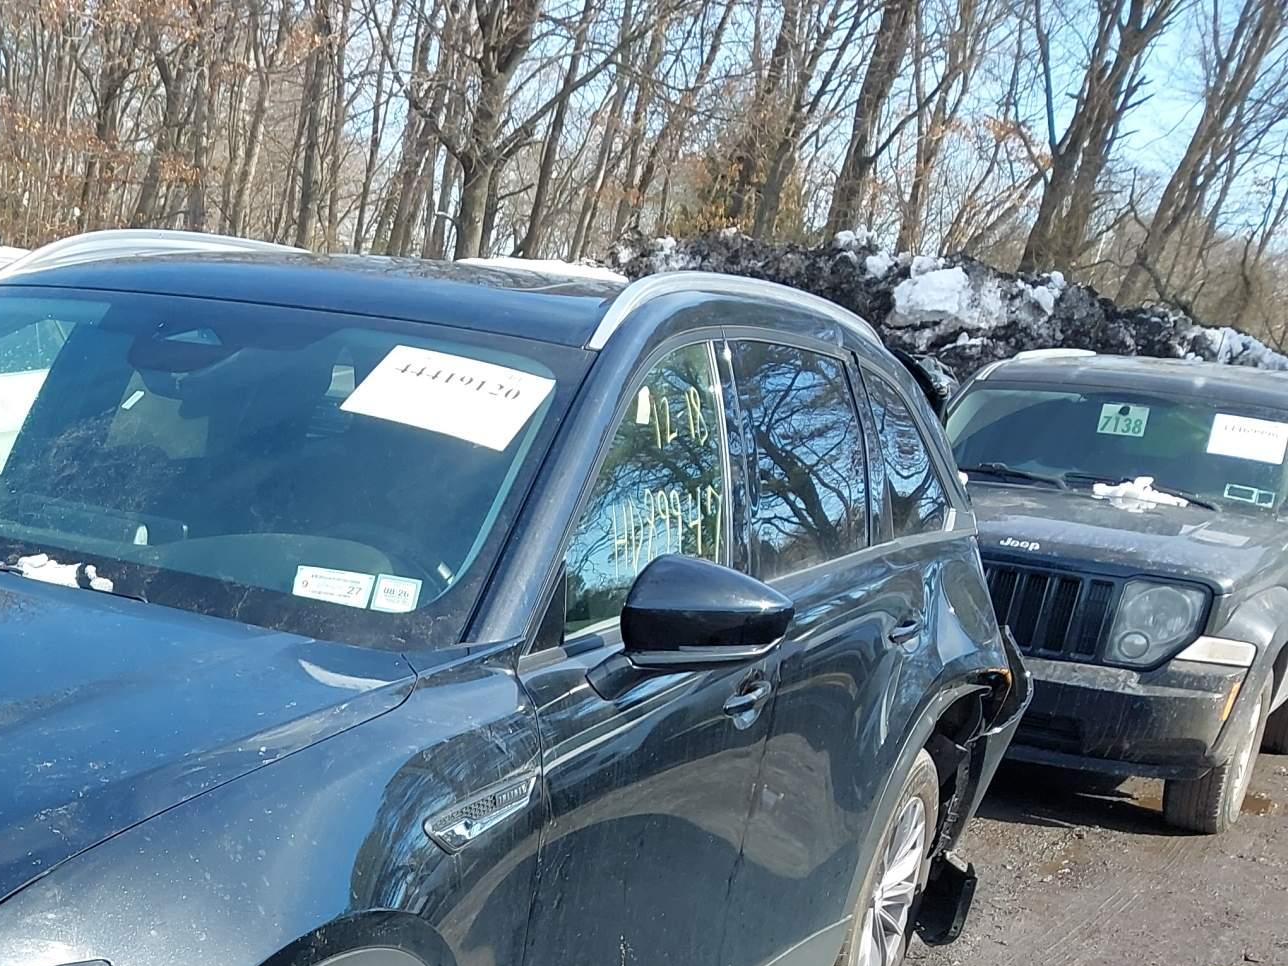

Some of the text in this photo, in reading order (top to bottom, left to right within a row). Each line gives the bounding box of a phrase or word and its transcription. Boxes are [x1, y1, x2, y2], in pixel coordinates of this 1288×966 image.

[395, 363, 521, 400] 44419120
[1100, 415, 1143, 434] 7138
[999, 537, 1040, 551] Jeep
[346, 585, 363, 596] 27
